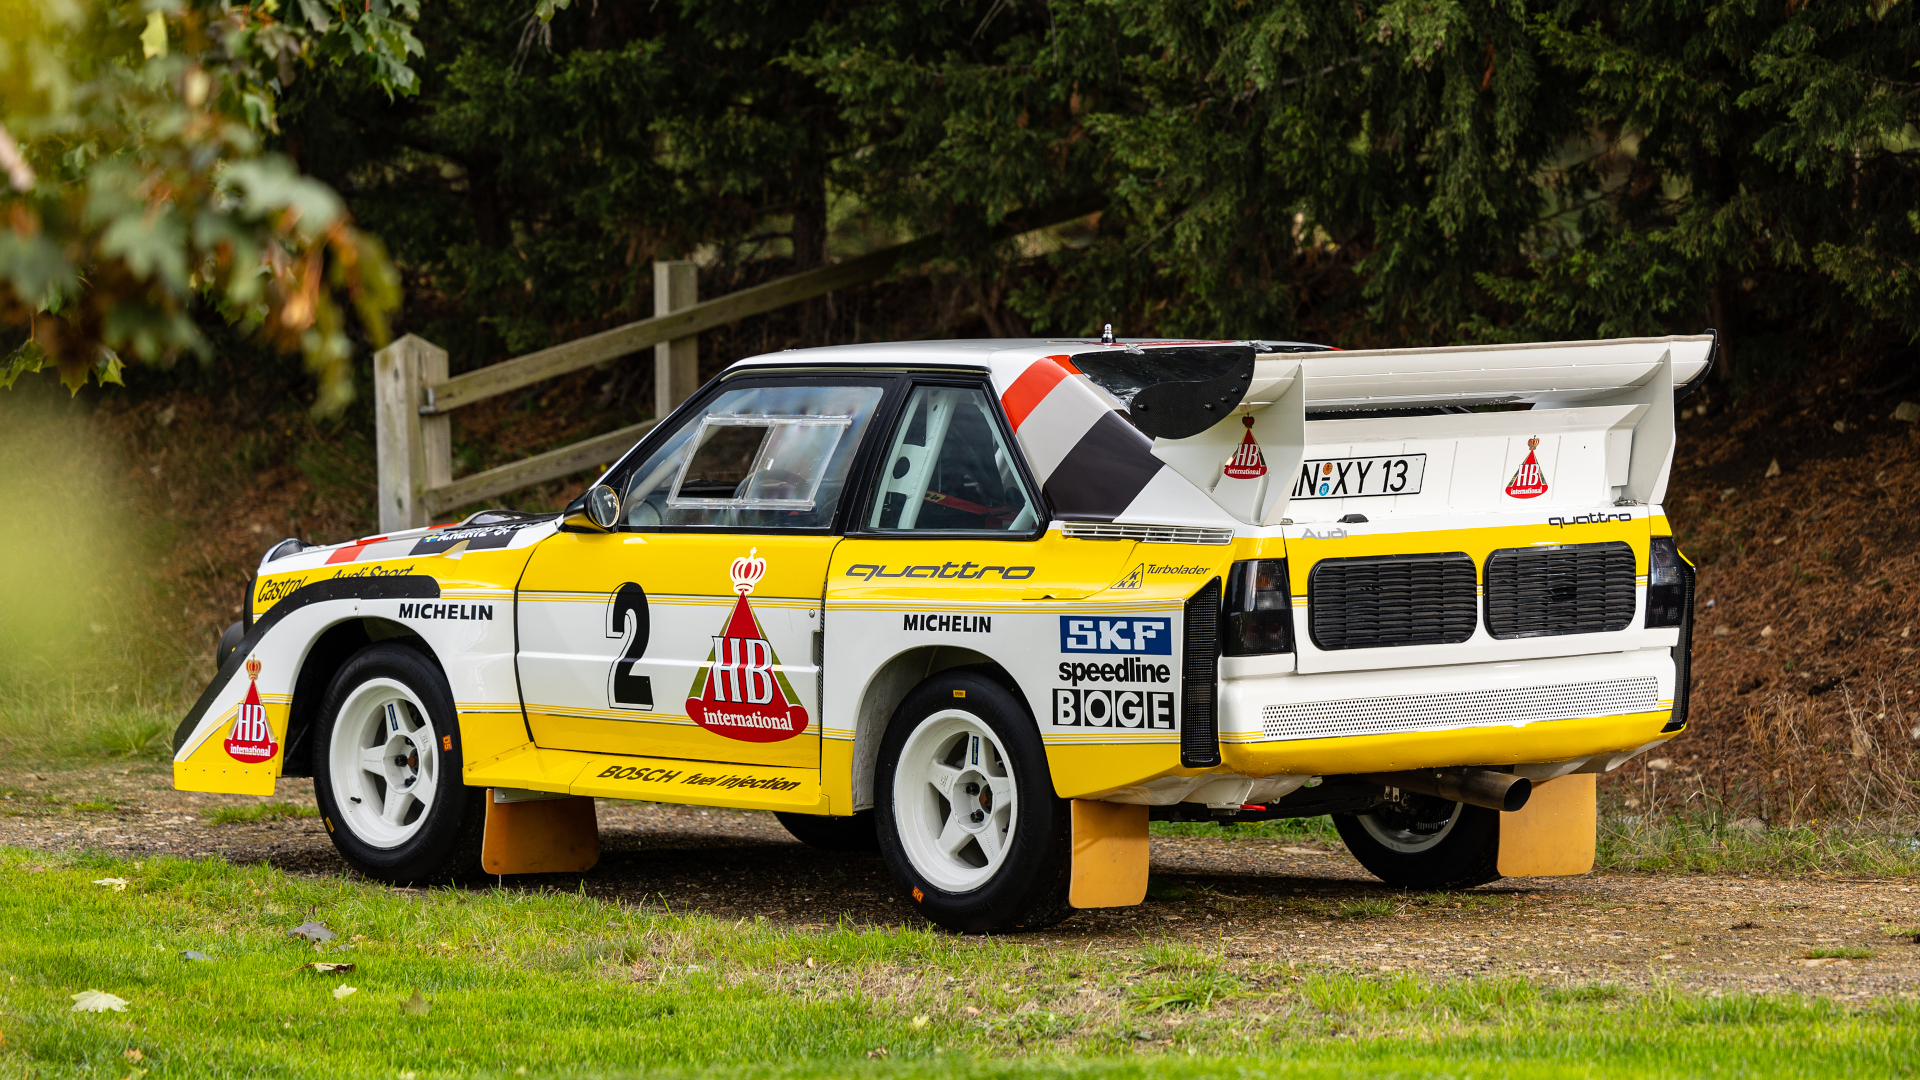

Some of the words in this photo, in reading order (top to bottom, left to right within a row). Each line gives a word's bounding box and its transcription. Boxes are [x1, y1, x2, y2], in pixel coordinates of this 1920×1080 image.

[1234, 443, 1259, 467] HB
[1227, 467, 1261, 476] international
[1382, 459, 1409, 493] 13
[1516, 464, 1540, 487] HB
[1510, 487, 1542, 495] international
[1548, 512, 1632, 529] quattro
[1300, 528, 1348, 540] Audi
[845, 561, 1036, 582] quattro
[1147, 564, 1211, 575] Turbolader
[398, 603, 494, 620] MICHELIN
[903, 614, 991, 633] MICHELIN
[606, 581, 654, 711] 2
[1066, 620, 1165, 651] SKF
[712, 635, 773, 705] HB
[1058, 657, 1171, 686] speedline
[702, 707, 794, 731] international
[1056, 690, 1173, 728] BOGE
[237, 703, 266, 742] HB
[230, 743, 271, 757] international
[443, 736, 451, 750] D5
[596, 765, 684, 784] BOSCH
[680, 773, 725, 786] fuel
[716, 774, 802, 791] injection
